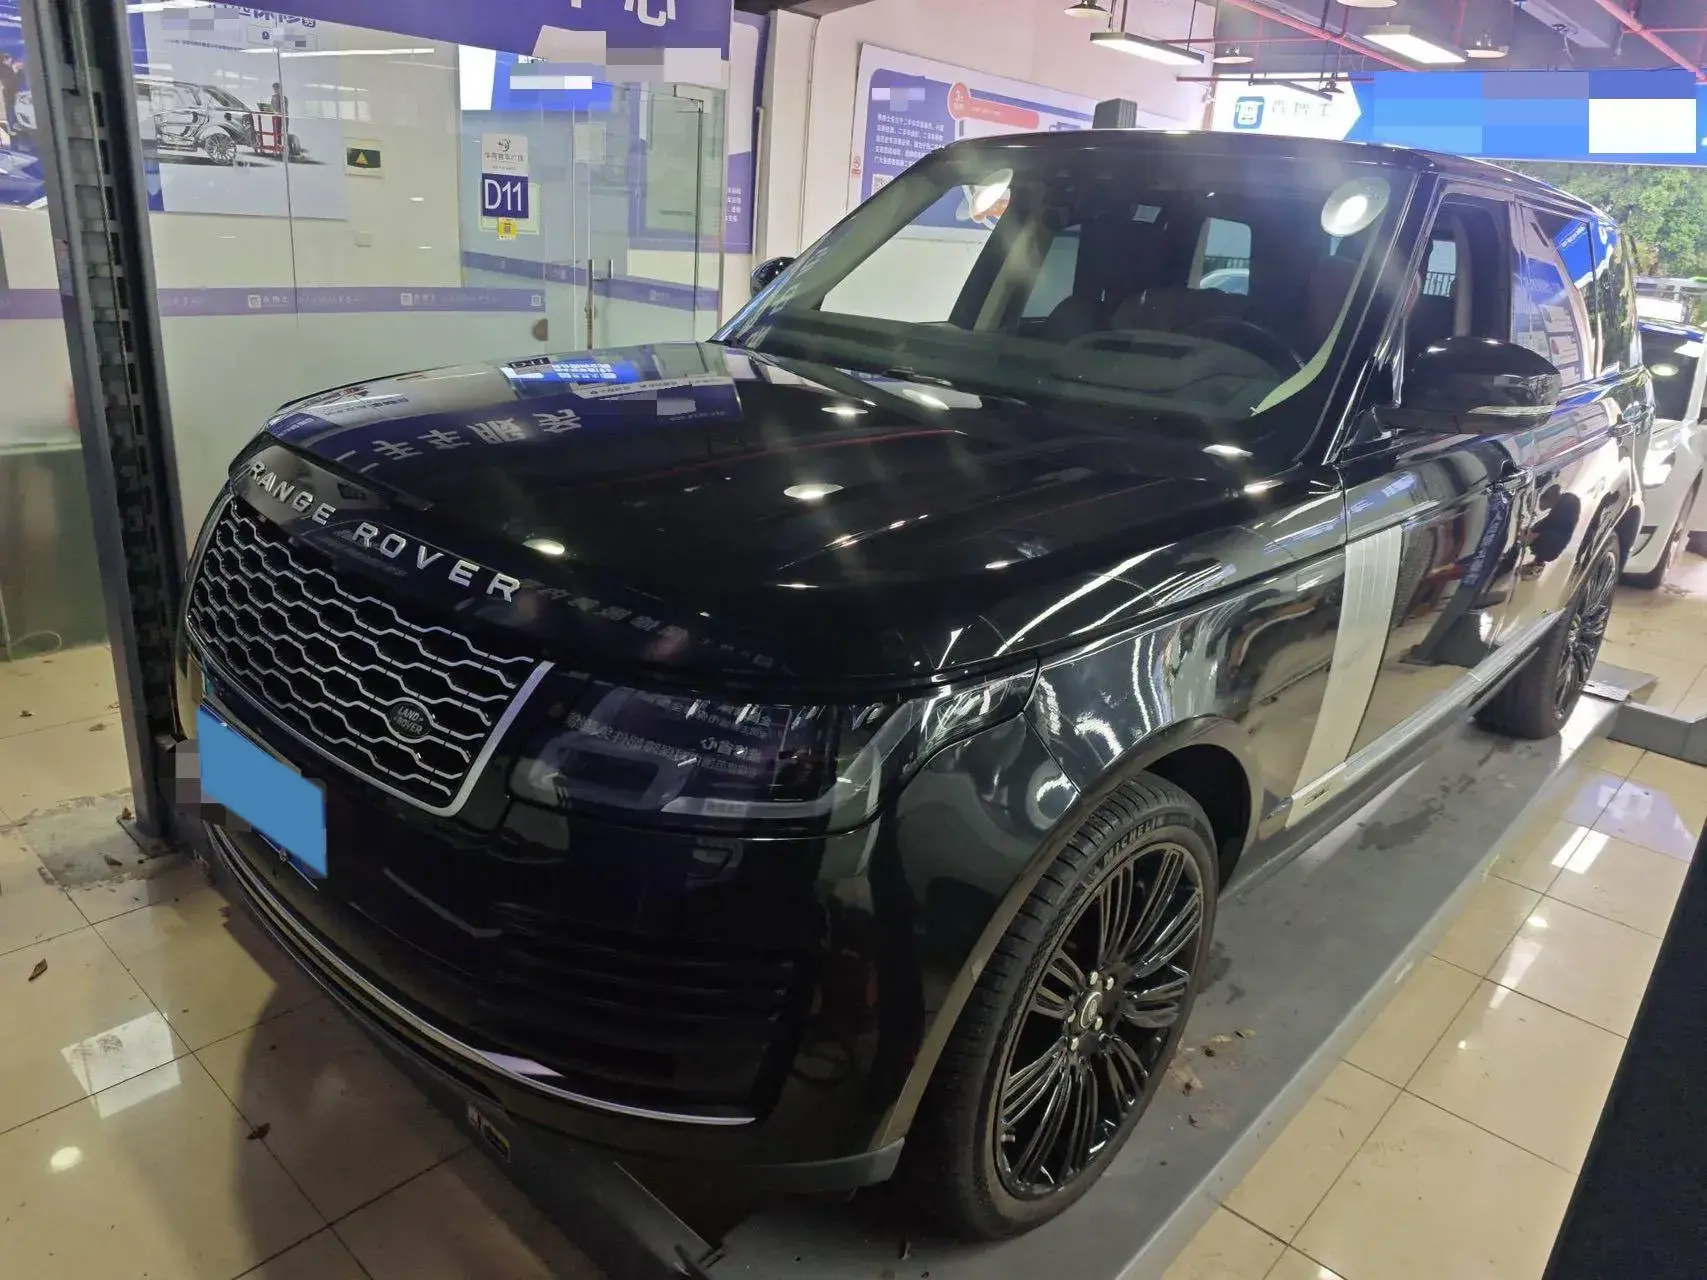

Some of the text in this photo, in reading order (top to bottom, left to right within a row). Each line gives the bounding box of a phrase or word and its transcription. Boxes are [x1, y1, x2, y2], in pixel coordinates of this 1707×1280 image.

[484, 178, 522, 211] D11
[249, 459, 521, 602] RANGE ROVER
[396, 716, 423, 736] ROVER
[398, 705, 420, 721] LAND
